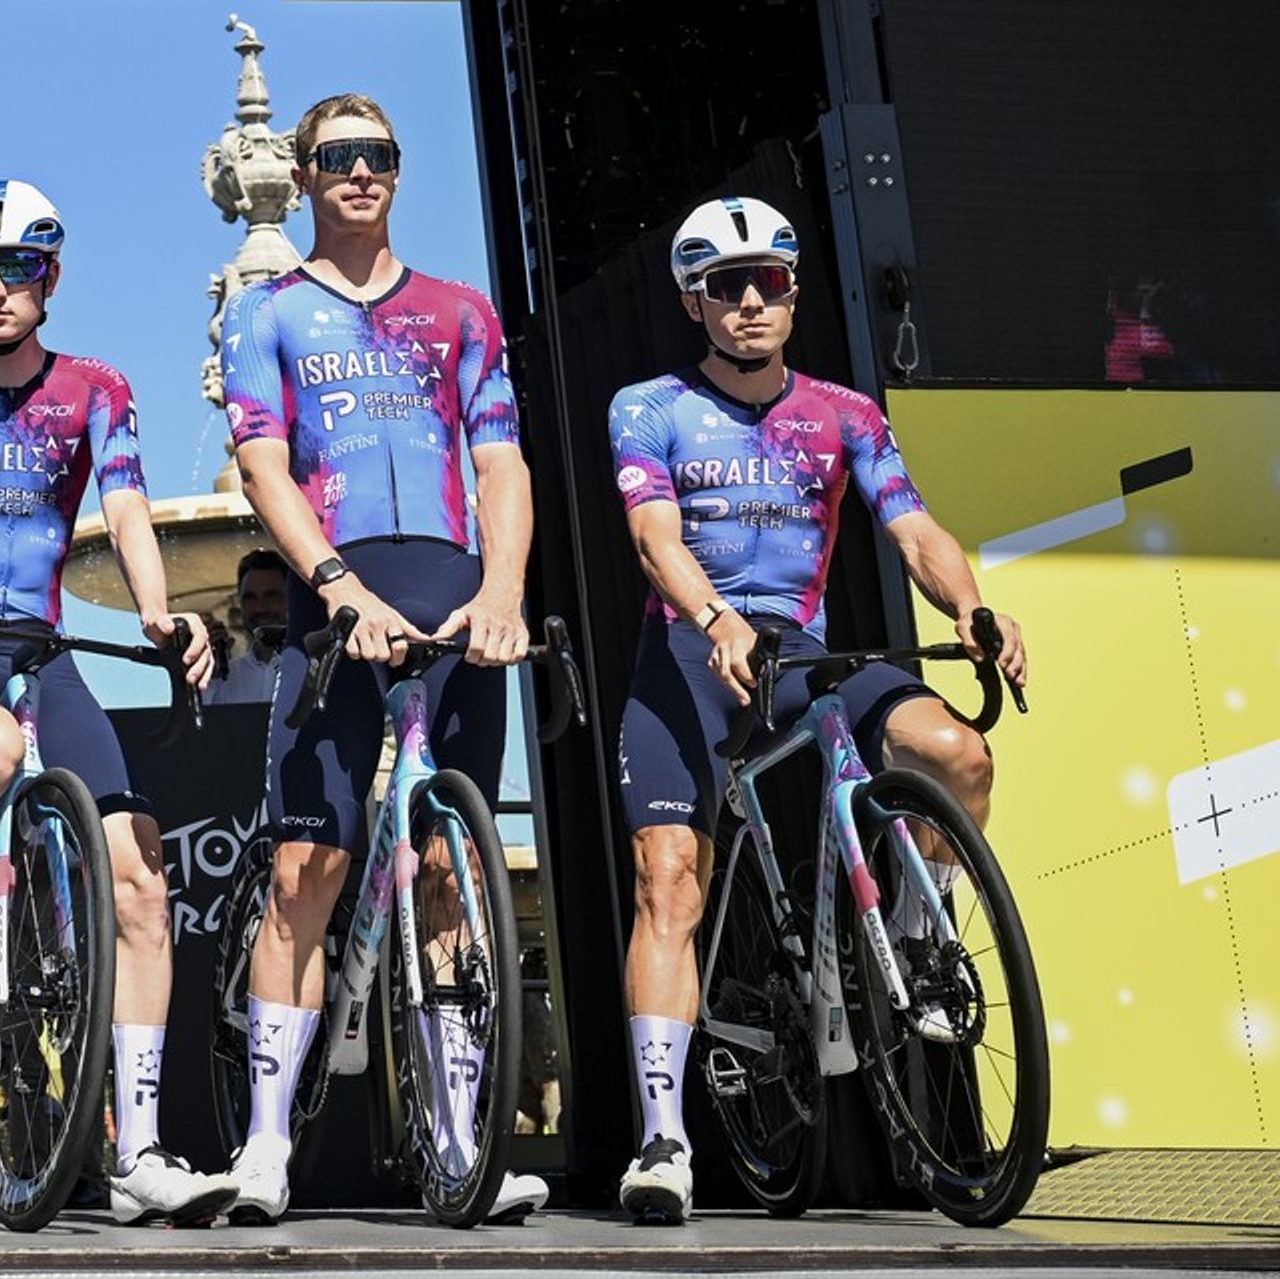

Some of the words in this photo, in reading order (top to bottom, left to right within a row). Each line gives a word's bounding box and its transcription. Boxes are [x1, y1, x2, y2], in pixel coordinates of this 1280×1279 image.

[297, 350, 395, 389] ISRAEL
[363, 393, 433, 410] PREMIER
[366, 407, 409, 421] TECH
[318, 432, 379, 463] FANTINI
[676, 459, 778, 489] ISRAEL
[739, 501, 811, 519] PREMIER
[739, 514, 784, 530] TECH
[160, 797, 269, 888] TOU
[400, 907, 415, 968] OSTRO
[867, 913, 891, 970] OSTRO
